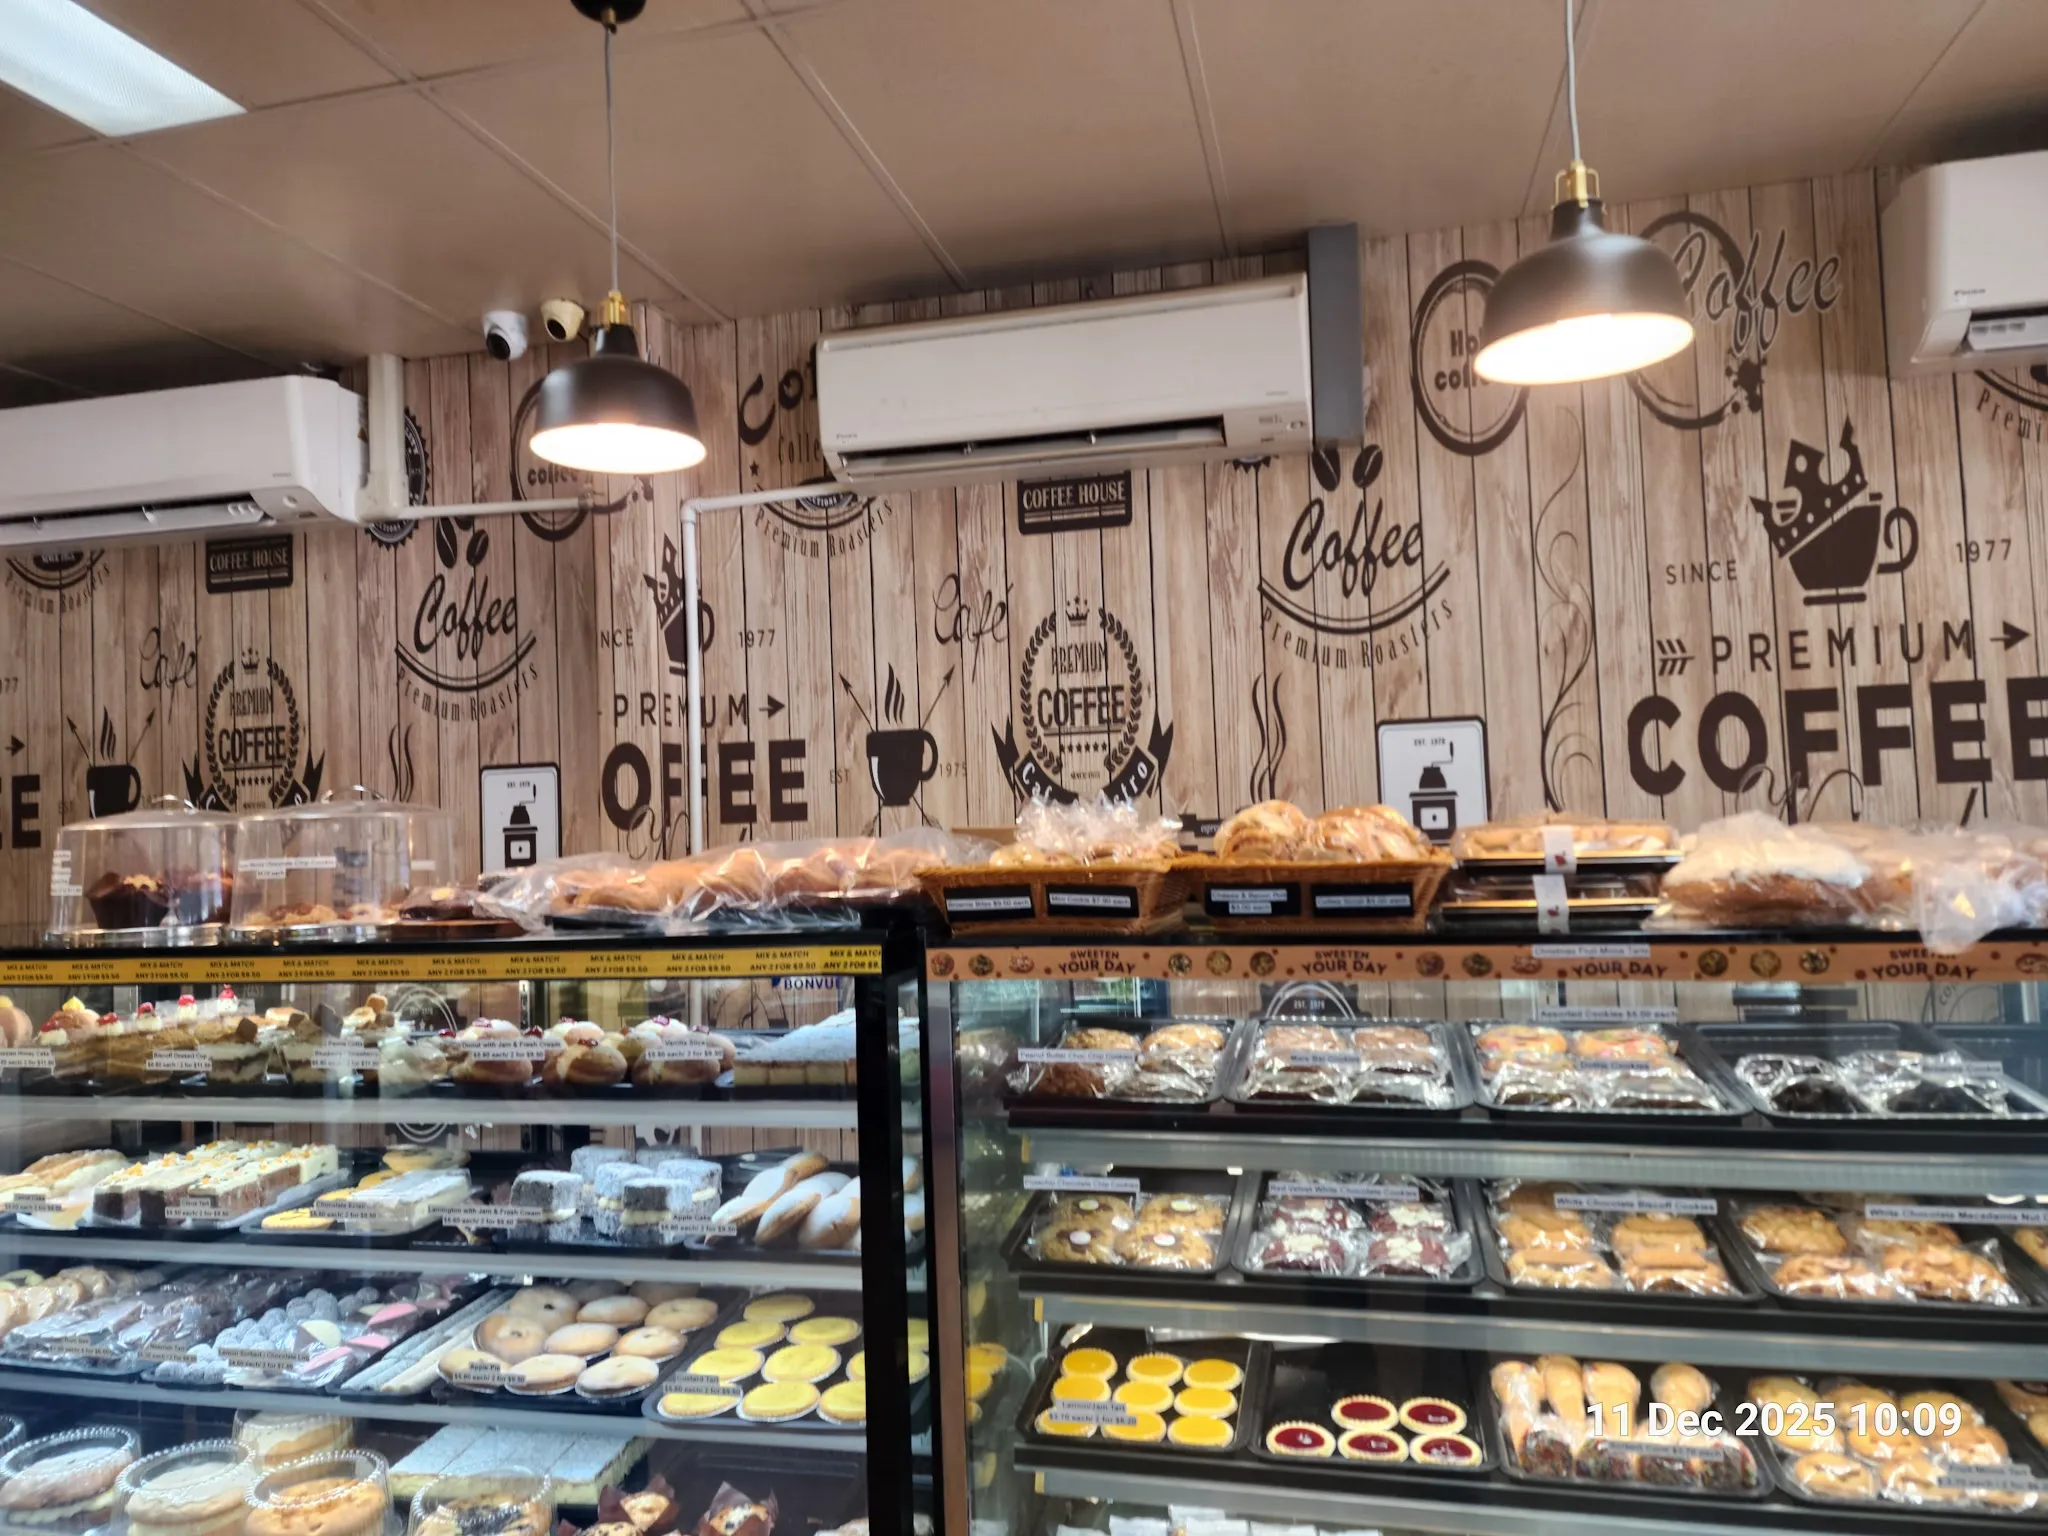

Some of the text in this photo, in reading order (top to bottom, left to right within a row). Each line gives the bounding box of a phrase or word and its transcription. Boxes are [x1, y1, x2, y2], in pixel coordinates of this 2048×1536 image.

[1023, 479, 1127, 510] COFFEE HOUSE
[754, 499, 893, 558] Premium Roasters
[210, 550, 289, 573] COFFEE HOUSE
[1283, 498, 1423, 599] Coffee
[1666, 538, 2012, 584] SINCE 1977
[413, 573, 518, 660] Coffee
[738, 629, 776, 649] 1977
[1261, 598, 1453, 669] Premium Roasters
[1712, 620, 1974, 675] PREMIUM
[1050, 640, 1109, 676] PREMIUM
[230, 686, 274, 717] PREMIUM
[398, 662, 539, 720] Premium Roasters
[1037, 685, 1126, 730] COFFEE
[614, 693, 748, 728] PREMUM
[218, 726, 286, 764] COFFEE
[1627, 677, 2048, 797] COFFEE
[602, 738, 808, 831] OFEE
[672, 953, 685, 961] MIX
[695, 953, 724, 961] MATCH
[751, 963, 766, 971] ANY
[775, 963, 791, 971] FOR
[756, 951, 770, 959] MIX
[780, 950, 809, 959] MATCH
[1059, 960, 1136, 975] YOUR DAY
[1070, 951, 1120, 961] SWEETEN
[1302, 960, 1388, 976] YOUR DAY
[1314, 950, 1370, 961] SWEETEN
[1572, 962, 1668, 978] YOUR DAY
[1873, 963, 1978, 979] YOUR DAY
